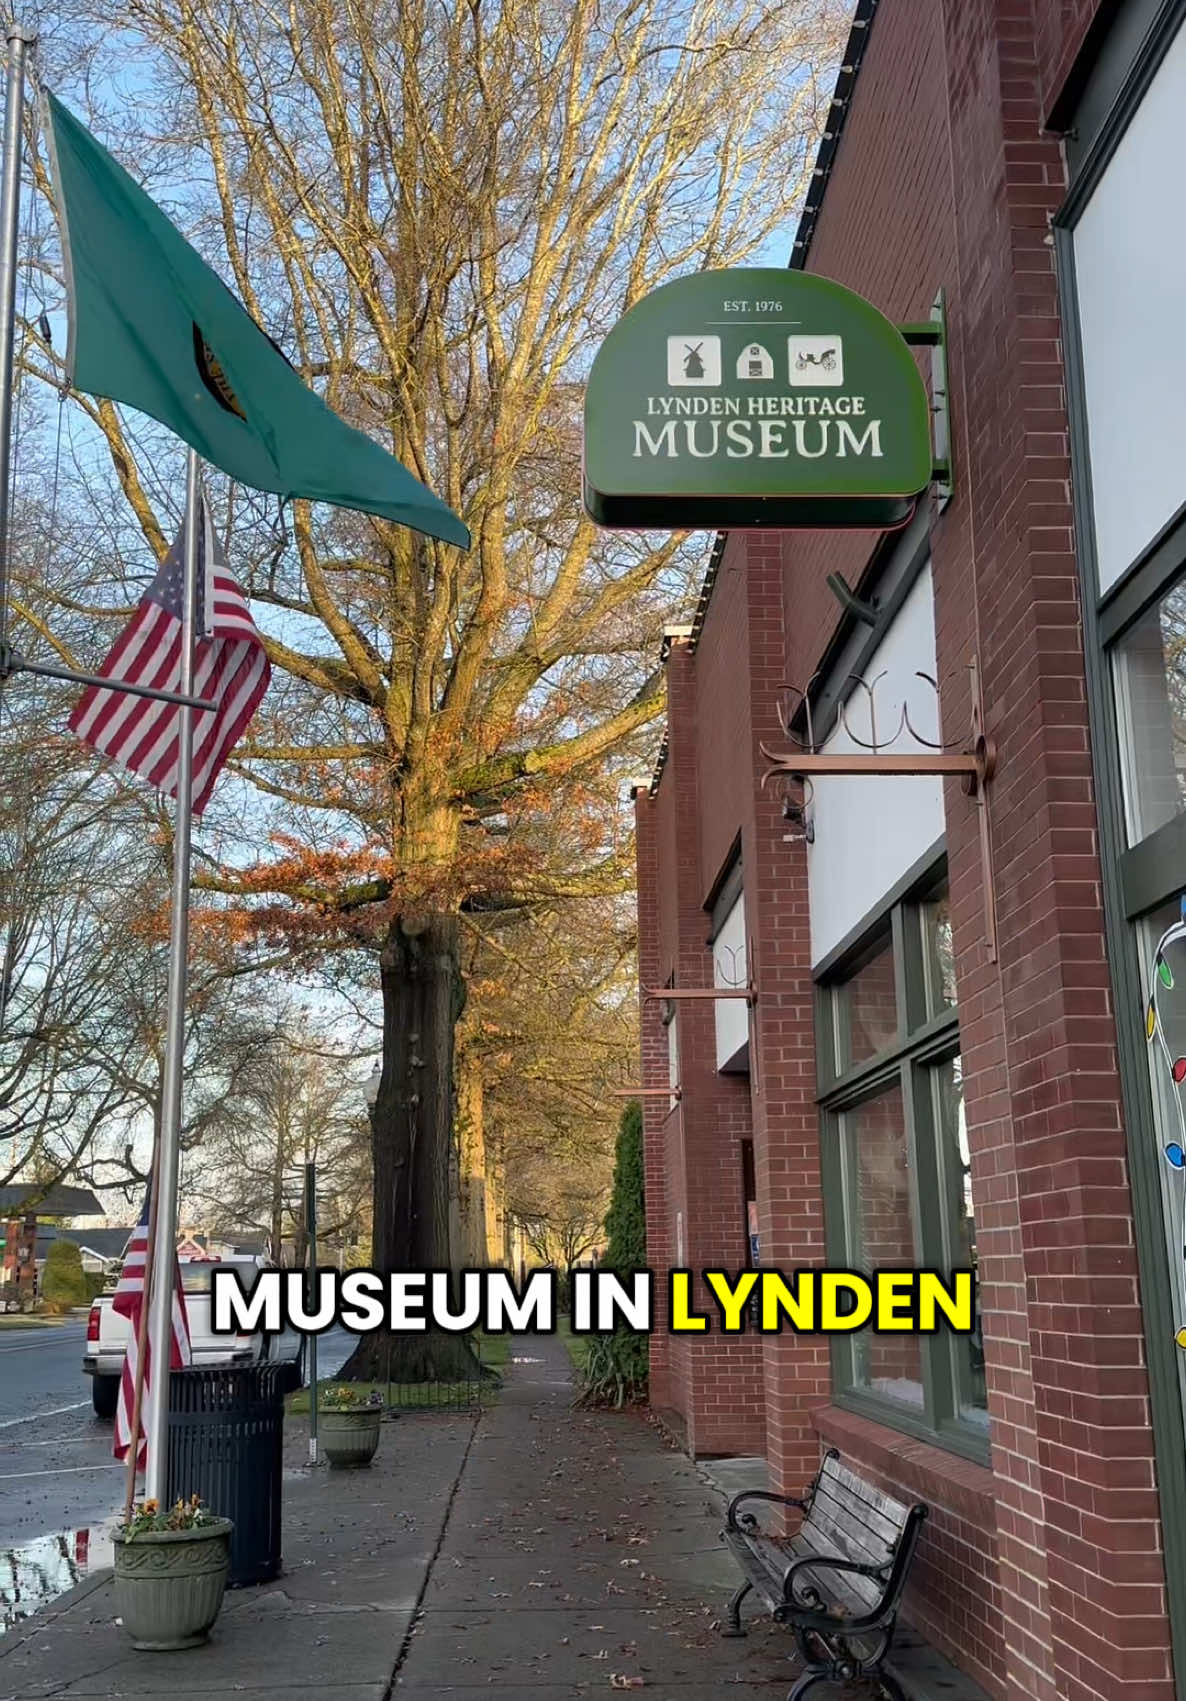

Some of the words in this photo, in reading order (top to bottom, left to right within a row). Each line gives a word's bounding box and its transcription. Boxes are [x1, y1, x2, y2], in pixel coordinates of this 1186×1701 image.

[723, 301, 751, 312] EST.
[755, 301, 783, 312] 1976
[647, 396, 741, 416] LYNDEN
[747, 396, 866, 416] HERITAGE
[631, 419, 884, 458] MUSEUM
